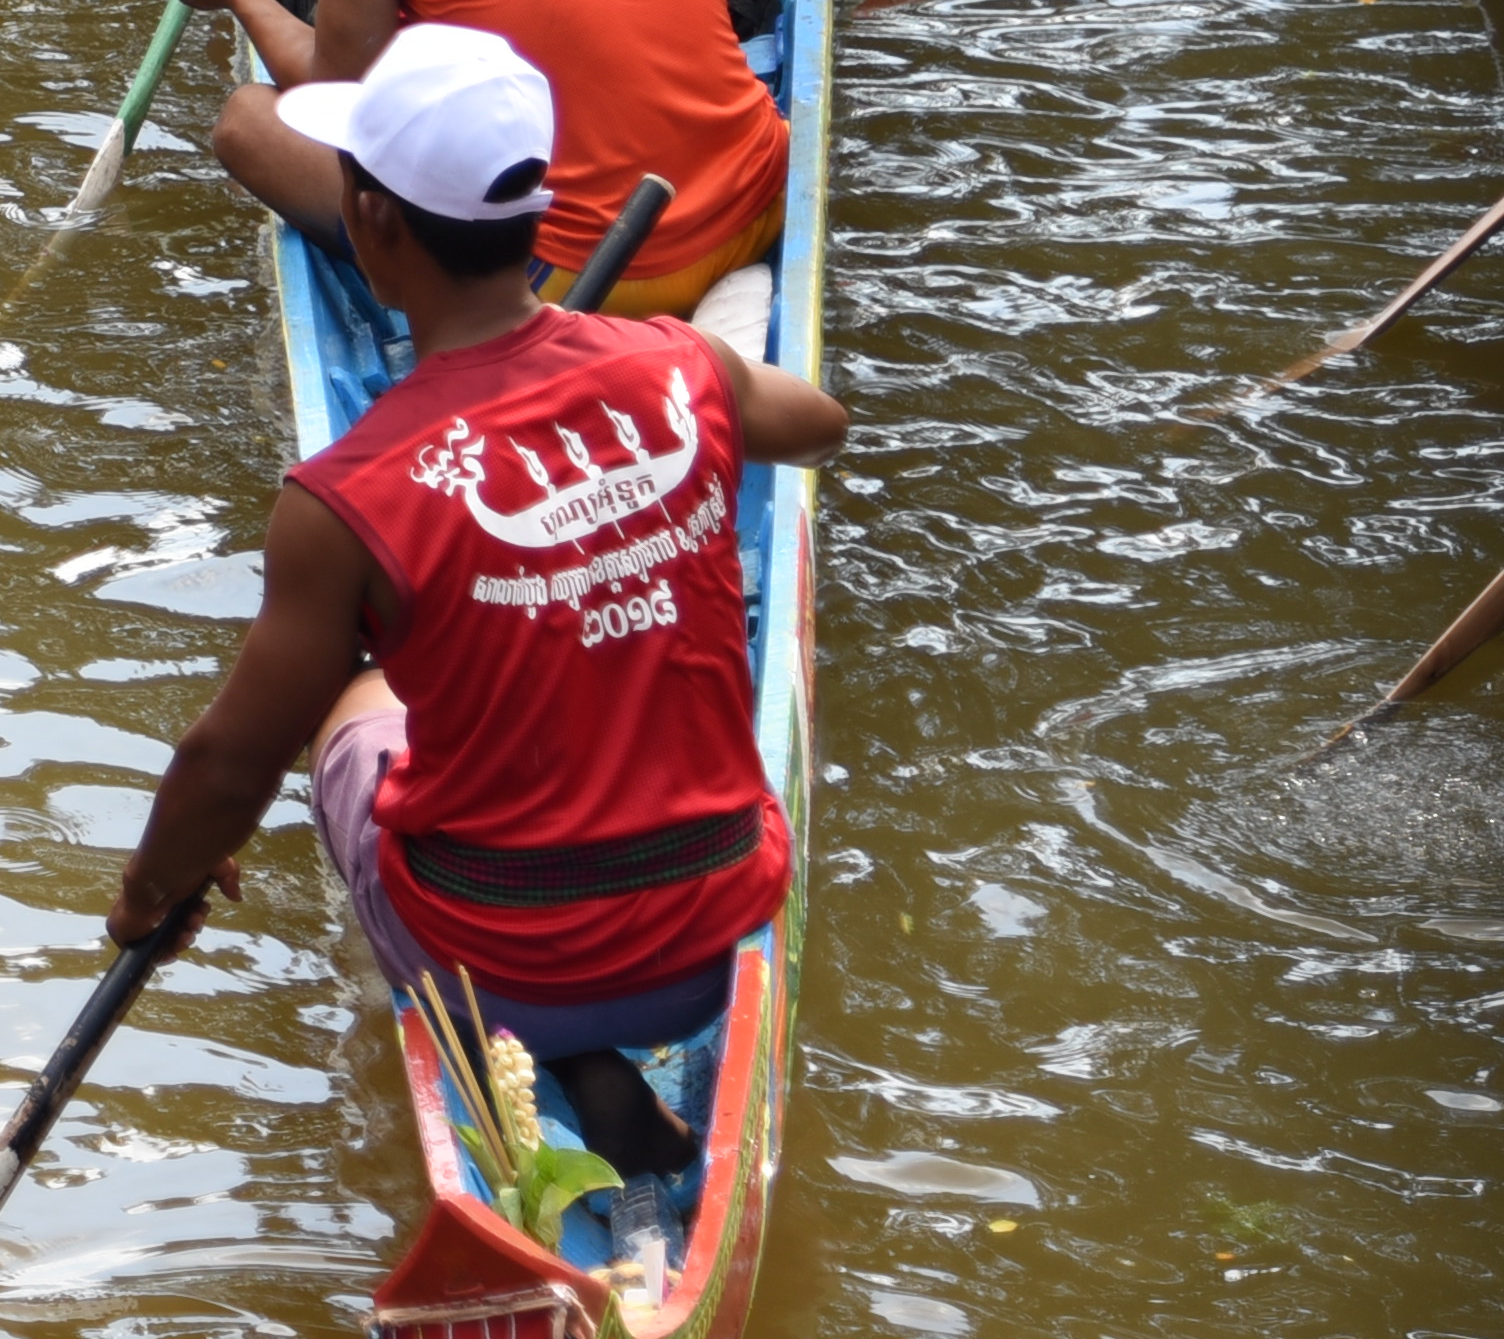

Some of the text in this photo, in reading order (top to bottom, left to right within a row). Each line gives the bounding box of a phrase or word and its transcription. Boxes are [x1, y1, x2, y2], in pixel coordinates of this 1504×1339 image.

[540, 474, 657, 540] បុណ្យអុំទូក
[676, 526, 690, 551] &
[581, 579, 678, 648] ២០១៨
